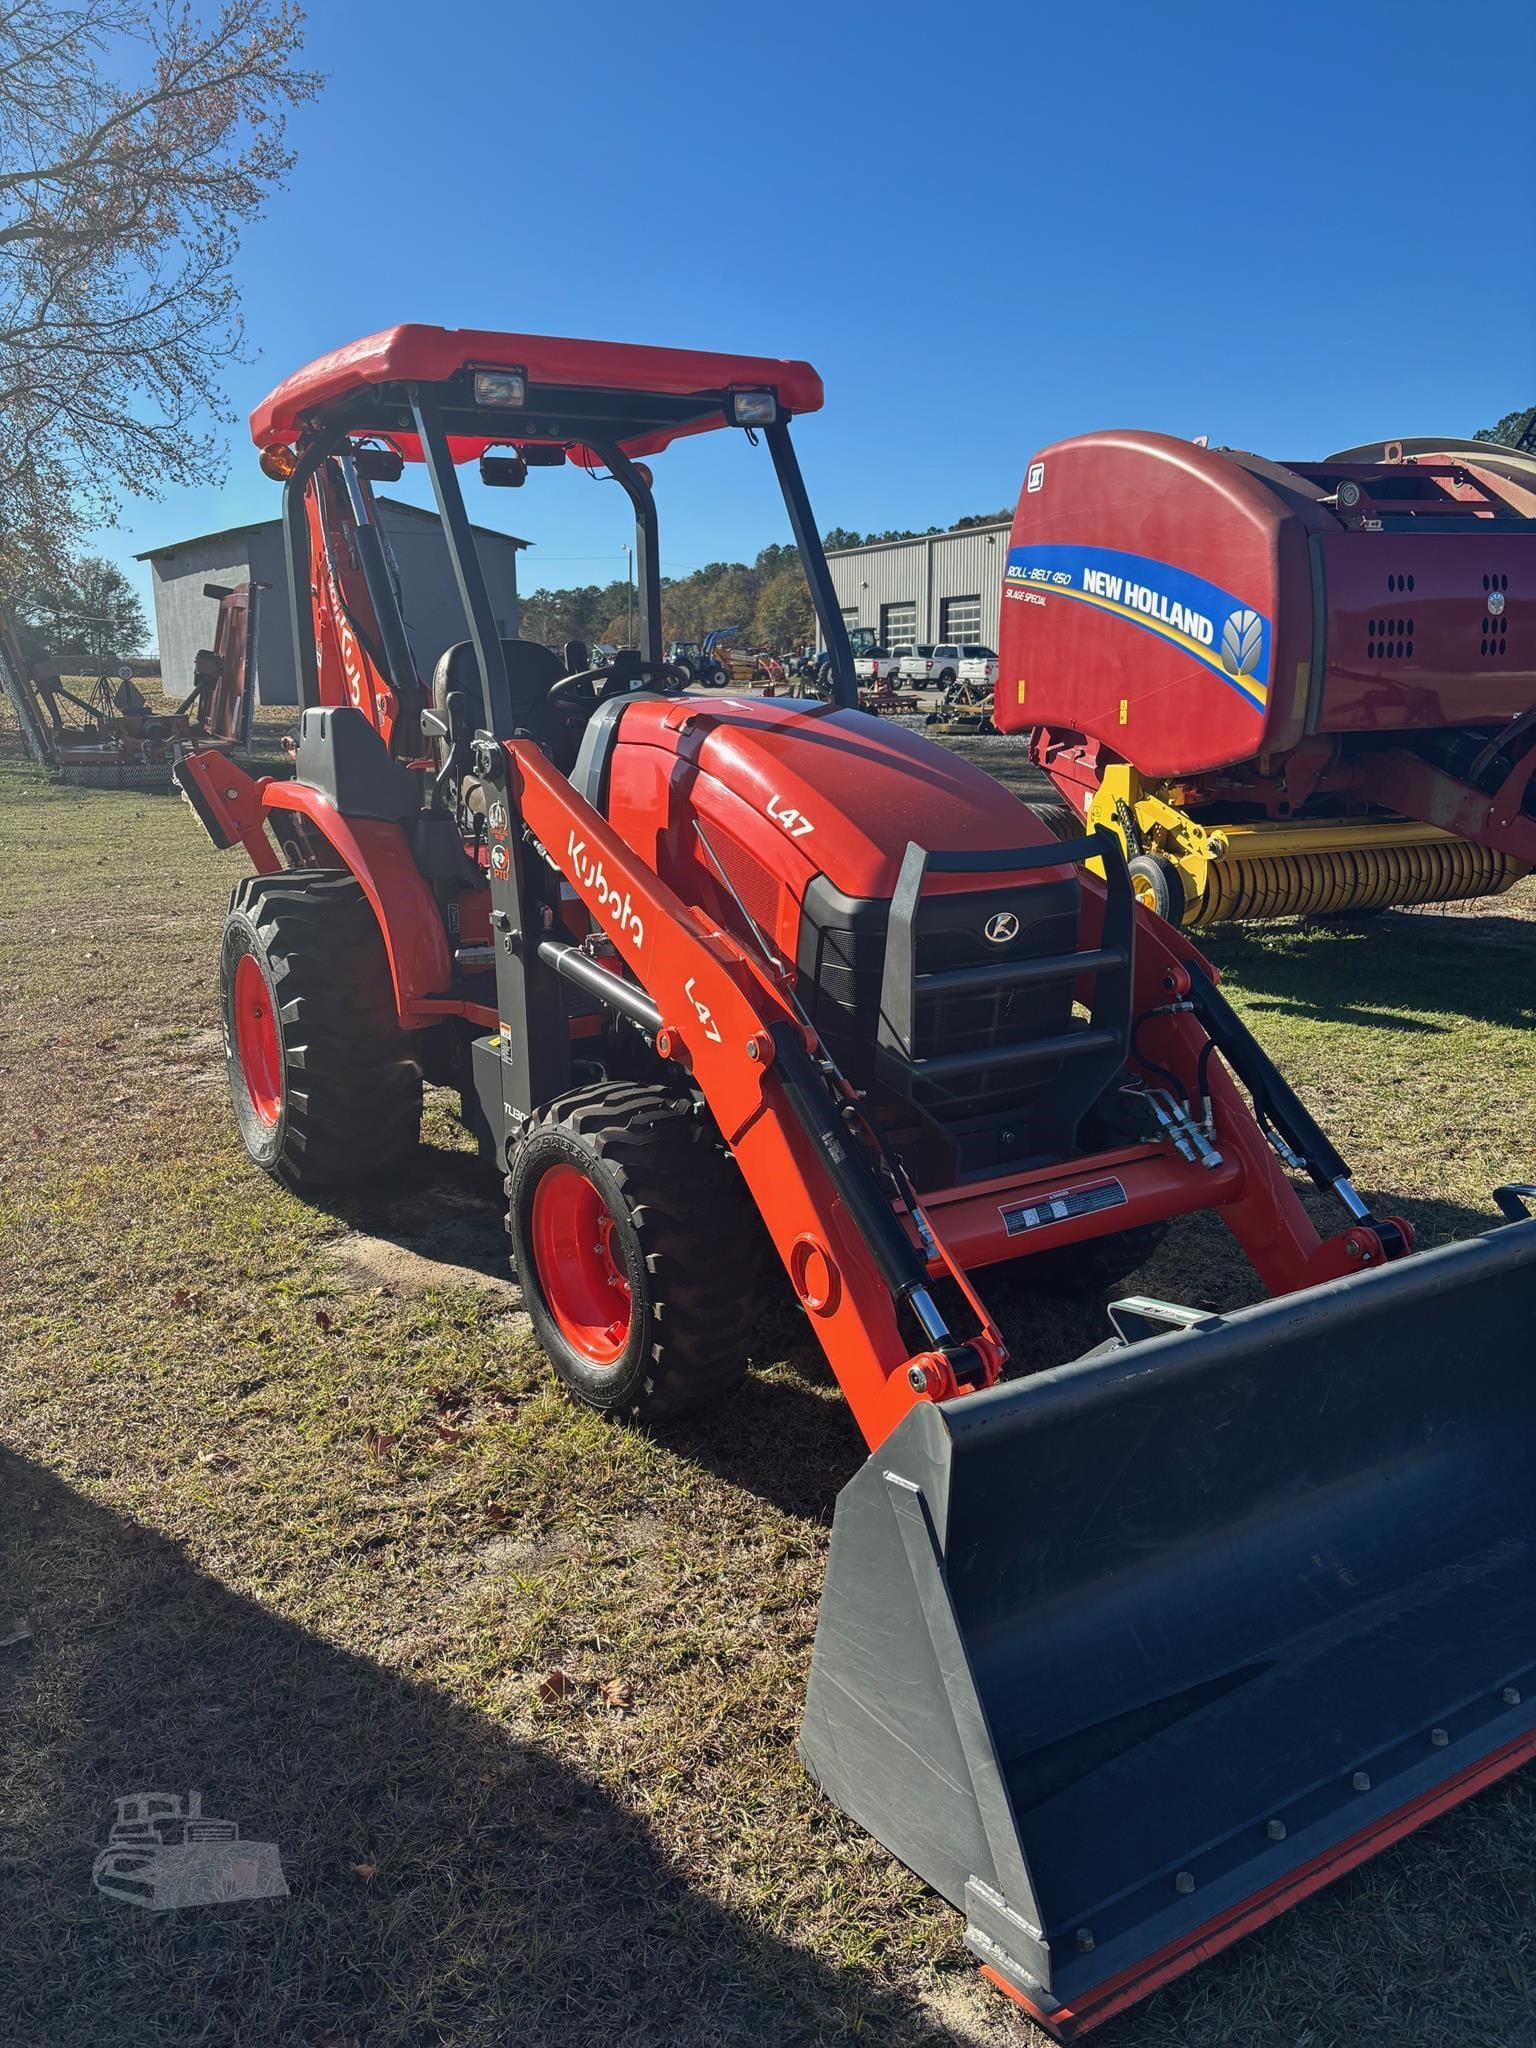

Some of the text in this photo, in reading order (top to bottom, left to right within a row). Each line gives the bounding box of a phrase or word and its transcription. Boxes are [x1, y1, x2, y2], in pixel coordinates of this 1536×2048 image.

[1005, 588, 1047, 607] SILAGE SPECIAL
[1052, 572, 1072, 586] 450
[1082, 567, 1214, 646] NEW HOLLAND
[766, 793, 816, 837] L47
[567, 829, 644, 950] Kubota
[684, 976, 722, 1043] L47
